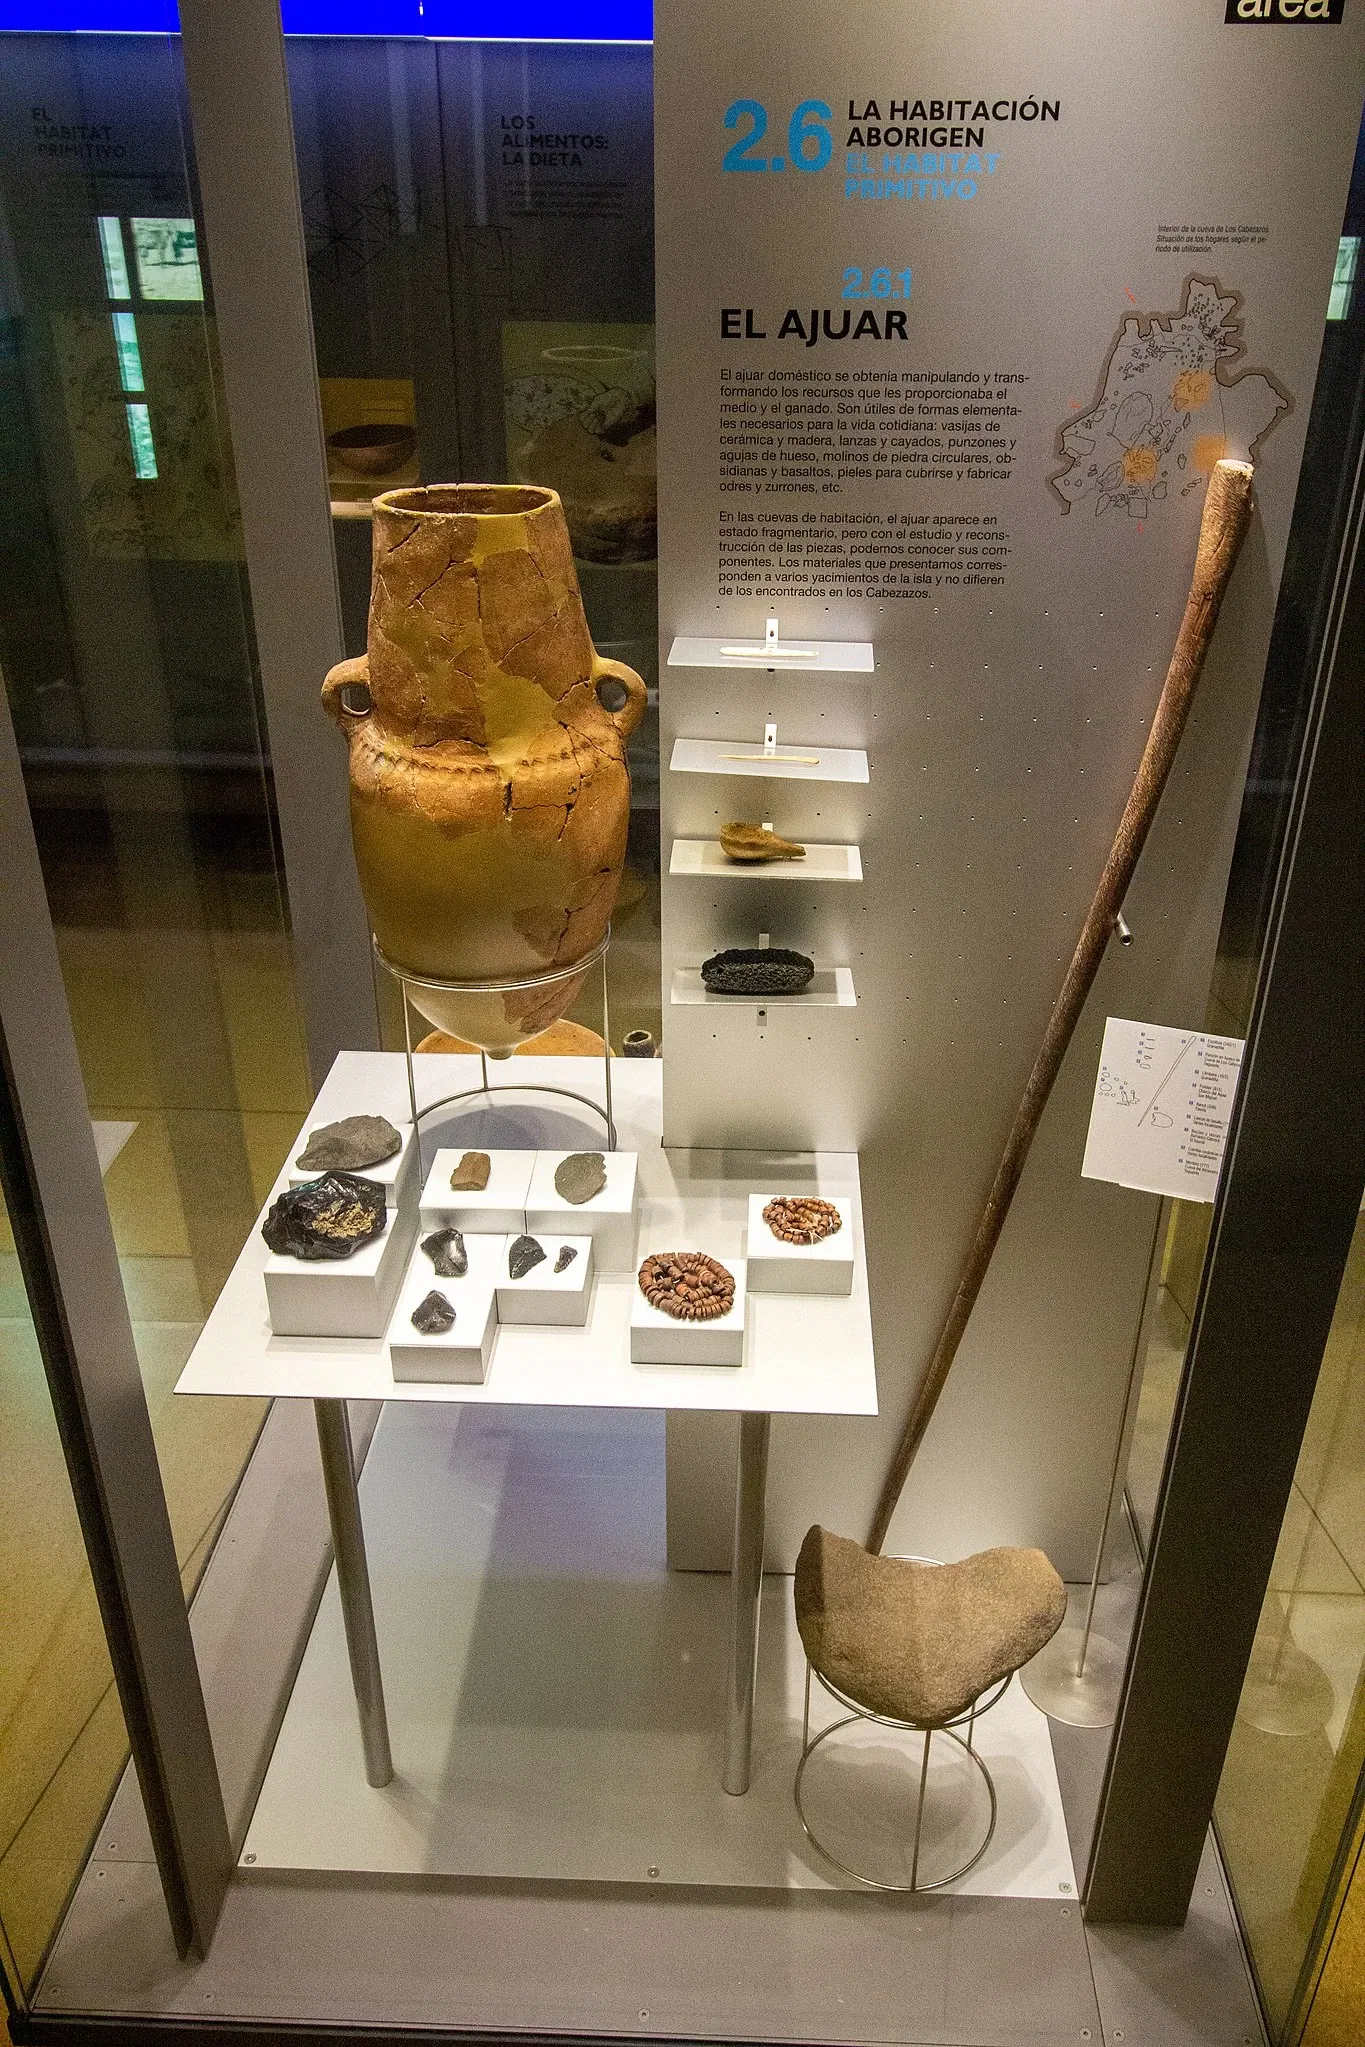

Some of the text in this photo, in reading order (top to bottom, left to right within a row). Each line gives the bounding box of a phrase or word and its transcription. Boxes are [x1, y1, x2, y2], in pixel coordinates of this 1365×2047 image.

[848, 95, 1061, 122] LA HABITACIÓN
[500, 115, 536, 130] LOS
[722, 99, 834, 173] 2.6
[846, 126, 985, 148] ABORIGEN
[502, 151, 583, 167] LA DIETA
[845, 153, 1001, 175] EL HABITAT
[845, 179, 979, 201] PRIMITIVO
[841, 267, 913, 300] 2.6.1
[721, 309, 909, 347] EL AJUAR
[720, 368, 1030, 386] El ajuar doméstico se obtenía manipulando y trans-
[720, 385, 1008, 401] formando los recursos que les proporcionaba el
[719, 402, 1022, 416] medio y el ganado. Son útiles de formas elementa-
[719, 418, 1001, 434] les necesarios para la vida cotidiana: vasijas de
[719, 434, 1017, 451] cerámica y madera, lanzas y cayados, punzones y
[719, 450, 1016, 464] agujas de hueso, molinos de piedra circulares, ob-
[719, 465, 1012, 481] sidianas y basaltos, pieles para cubrirse y fabricar
[719, 480, 843, 494] odres y zurrones, etc.
[719, 510, 998, 527] En las cuevas de habitación, el ajuar aparece en
[718, 526, 1010, 542] estado fragmentario, pero con el estudio y recons-
[718, 541, 1012, 556] trucción de las piezas, podemos conocer sus com-
[718, 556, 1007, 571] ponentes. Los materiales que presentamos corres-
[718, 570, 1005, 586] ponden a varios yacimientos de la isla y no difieren
[717, 584, 931, 599] de los encontrados en los Cabezazos.
